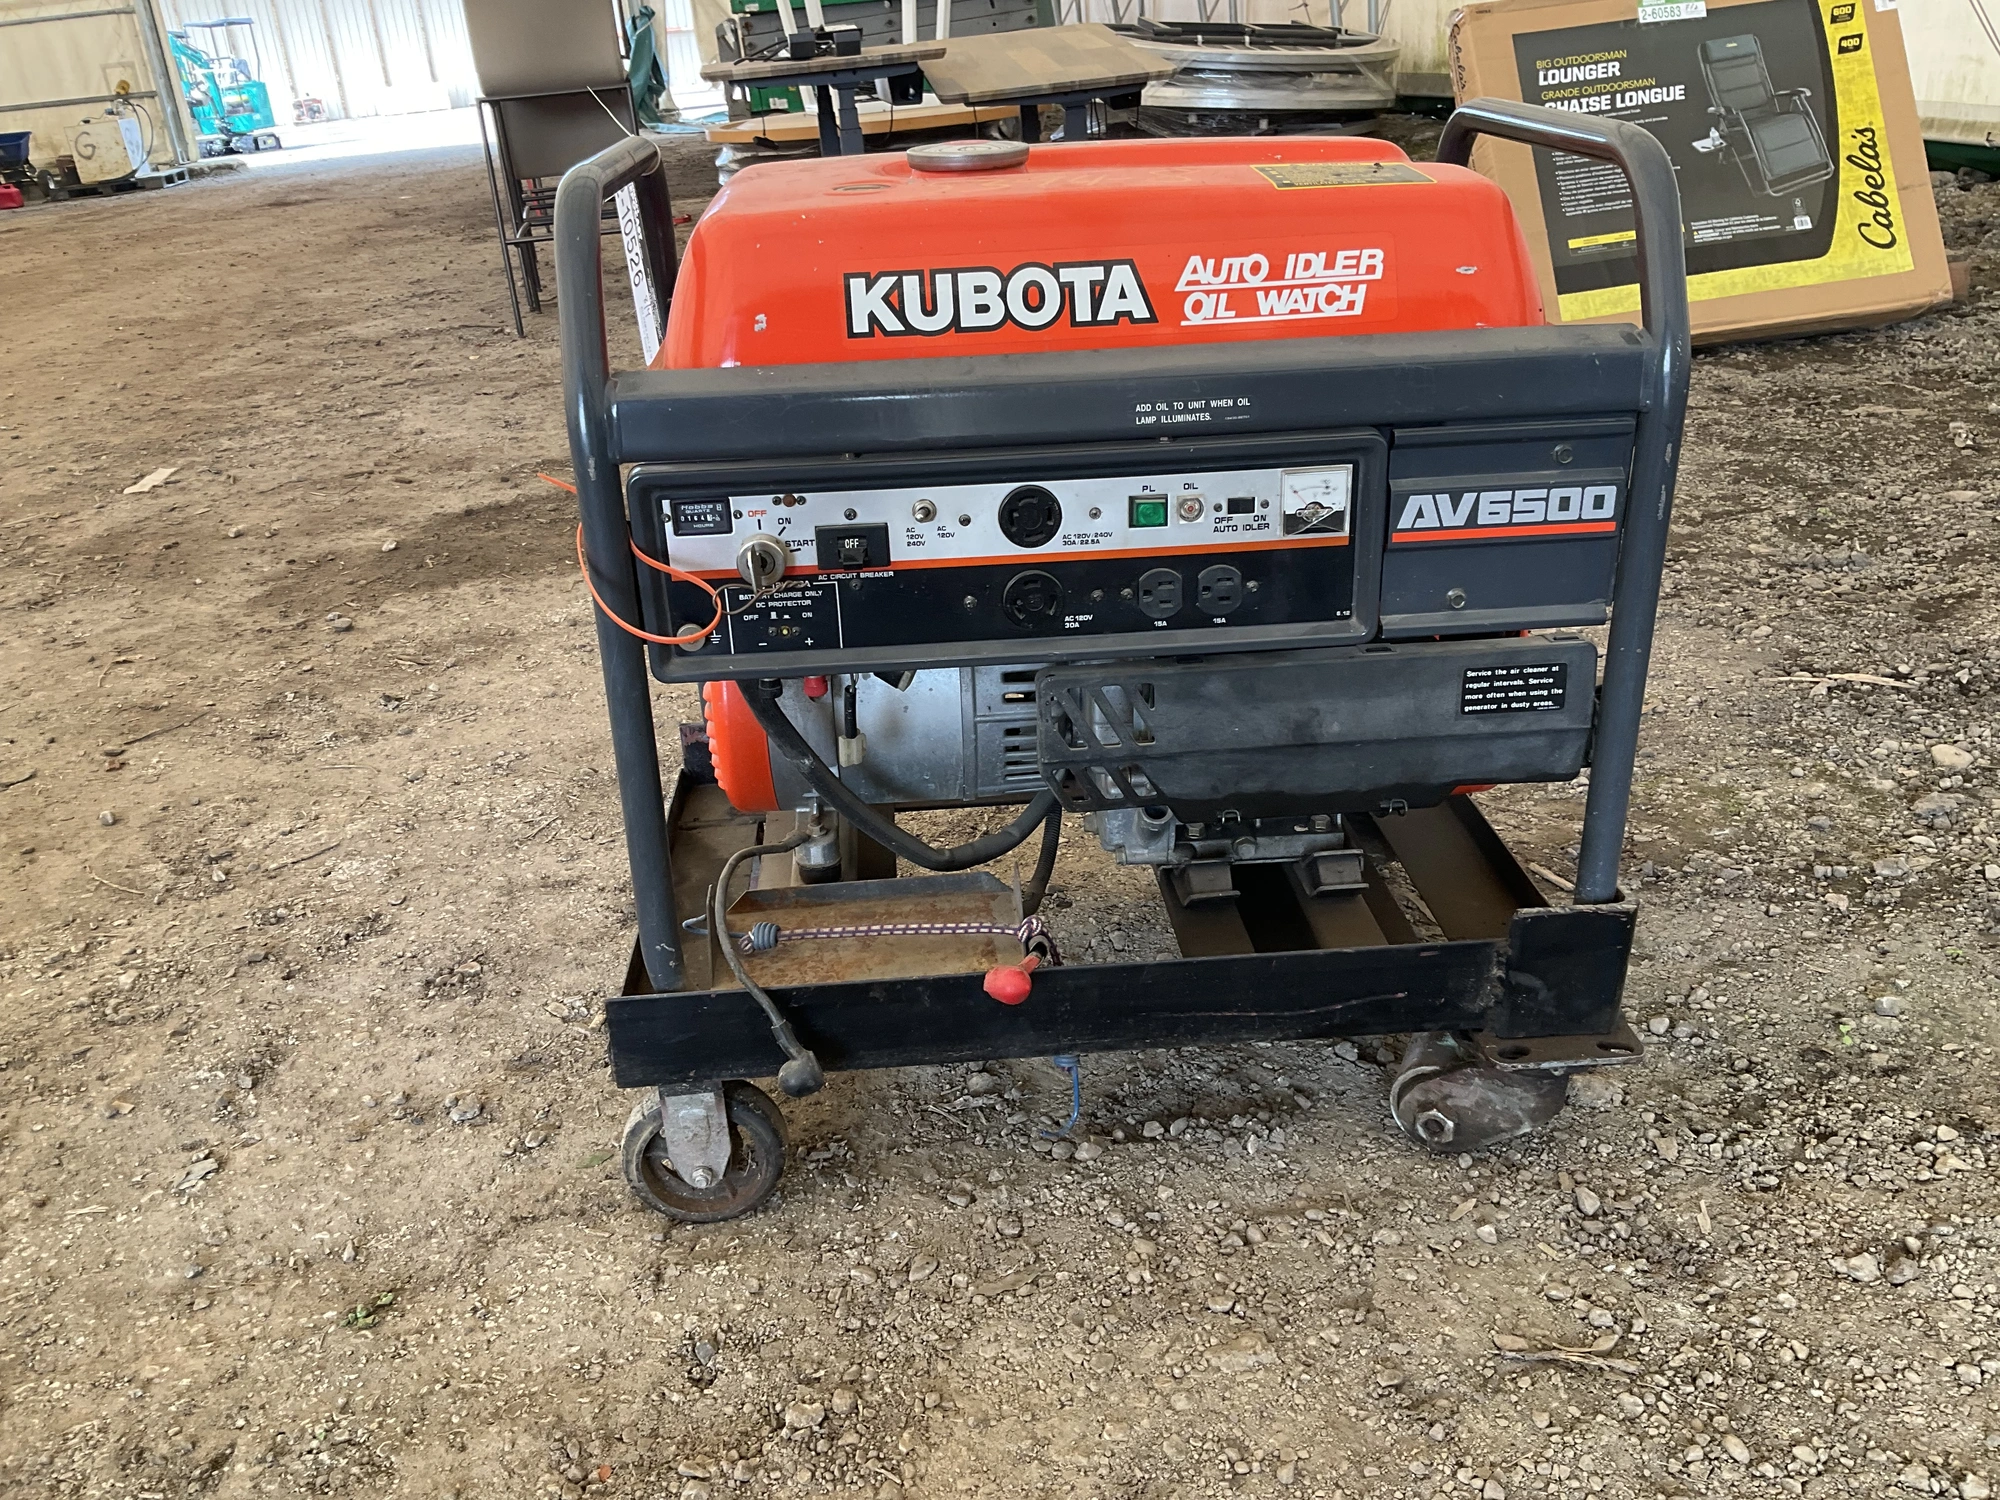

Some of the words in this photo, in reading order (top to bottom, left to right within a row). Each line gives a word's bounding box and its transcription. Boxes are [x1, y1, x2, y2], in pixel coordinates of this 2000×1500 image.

[1640, 6, 1682, 20] 2-60583
[1833, 6, 1852, 16] 600
[1840, 38, 1860, 47] 400
[1536, 59, 1552, 70] BIG
[1554, 50, 1627, 68] OUTDOORSMAN
[1538, 61, 1621, 86] LOUNGER
[1541, 88, 1580, 100] GRANDE
[1582, 77, 1656, 96] OUTDOORSMAN
[1616, 85, 1686, 108] LONGUE
[74, 132, 96, 160] G
[1846, 127, 1897, 249] Cabela's
[1177, 252, 1268, 288] AUTO
[1284, 248, 1384, 280] IDLER
[847, 261, 1155, 336] KUBOTA
[1184, 291, 1237, 322] OIL
[1258, 283, 1368, 318] WATCH
[1136, 404, 1152, 412] ADD
[1156, 402, 1168, 412] OIL
[1173, 402, 1184, 410] TO
[1188, 400, 1206, 410] UNIT
[1210, 399, 1234, 408] WHEN
[1237, 398, 1250, 406] OIL
[1136, 416, 1156, 424] LAMP
[1161, 412, 1212, 424] ILLUMINATES.
[1182, 482, 1198, 490] OIL
[1396, 485, 1617, 529] AV6500
[748, 510, 768, 518] OFF
[1214, 516, 1234, 524] OFF
[1213, 524, 1238, 533] AUTO
[1242, 522, 1270, 531] IDLER
[785, 539, 815, 548] START
[844, 538, 860, 549] OFF
[768, 600, 812, 608] PROTECTOR
[1523, 666, 1548, 674] cleaner
[1464, 704, 1498, 712] generator
